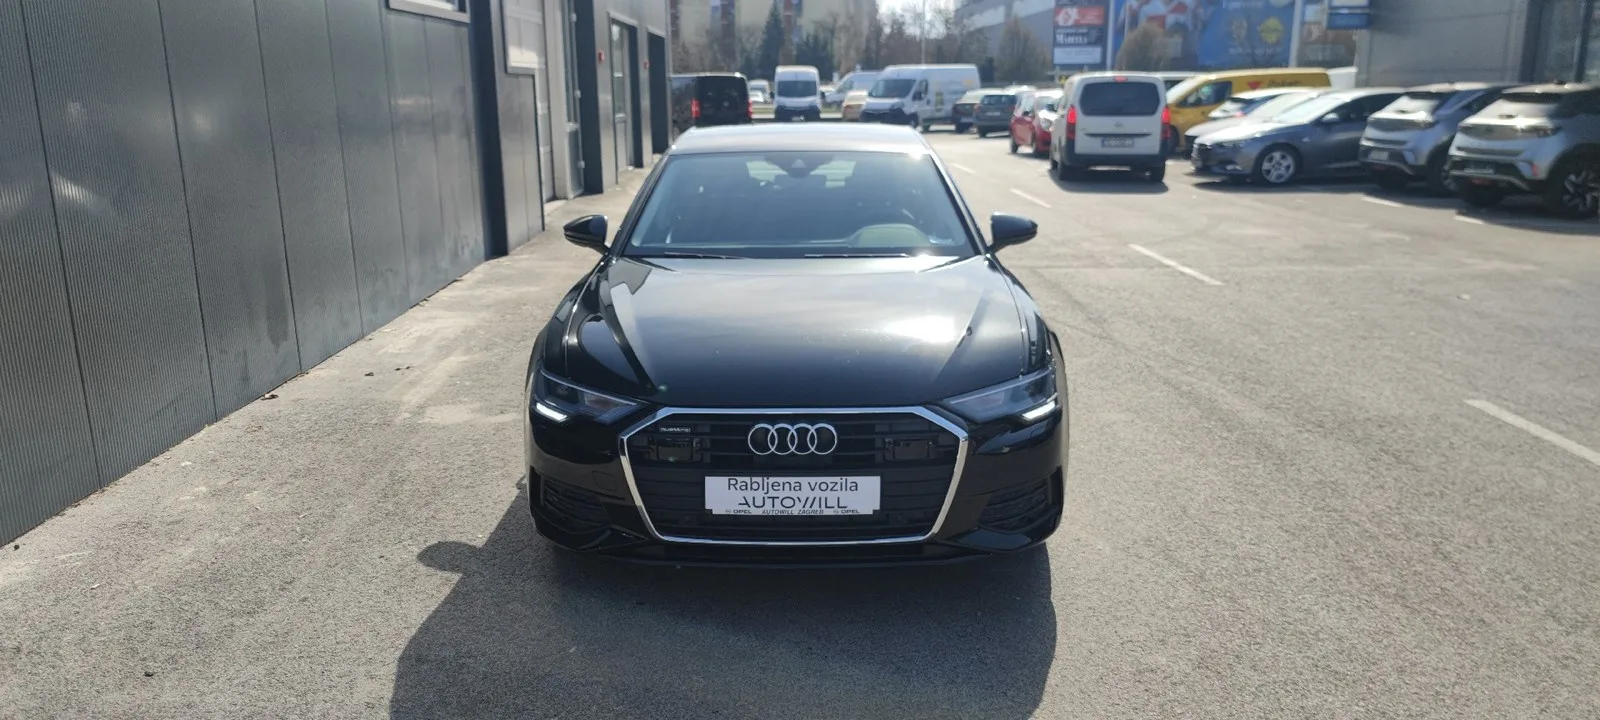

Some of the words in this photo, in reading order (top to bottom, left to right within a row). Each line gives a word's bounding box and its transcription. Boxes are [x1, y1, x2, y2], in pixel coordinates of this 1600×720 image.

[728, 478, 802, 494] Rabljena
[808, 477, 858, 492] vozila
[738, 496, 848, 509] AUTOWILL
